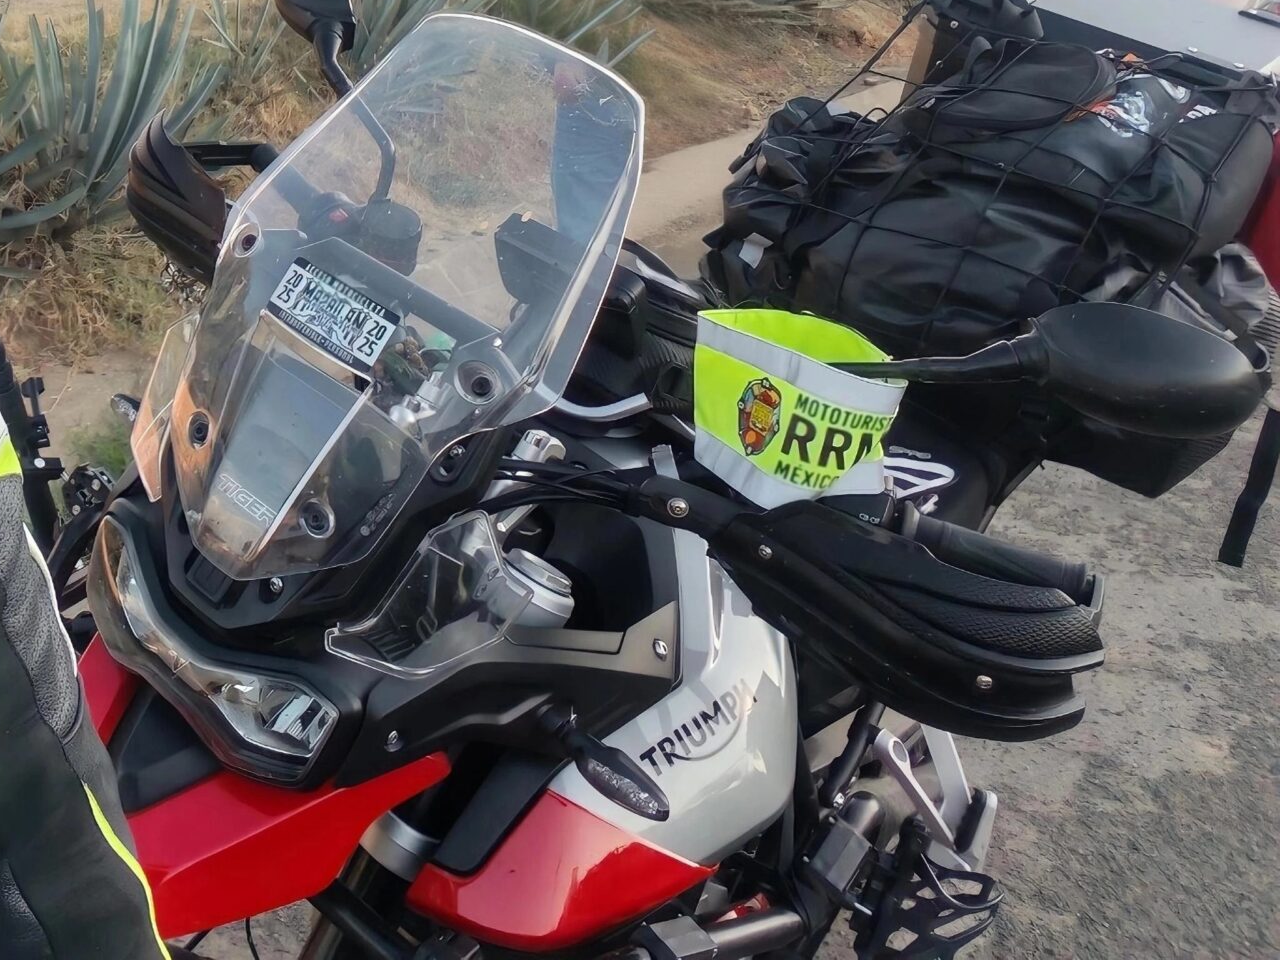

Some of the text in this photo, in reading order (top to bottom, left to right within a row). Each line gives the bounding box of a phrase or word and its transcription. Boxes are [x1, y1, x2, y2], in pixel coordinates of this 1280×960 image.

[285, 270, 304, 289] 20
[276, 284, 295, 304] 25
[366, 320, 388, 341] 20
[356, 337, 379, 358] 25
